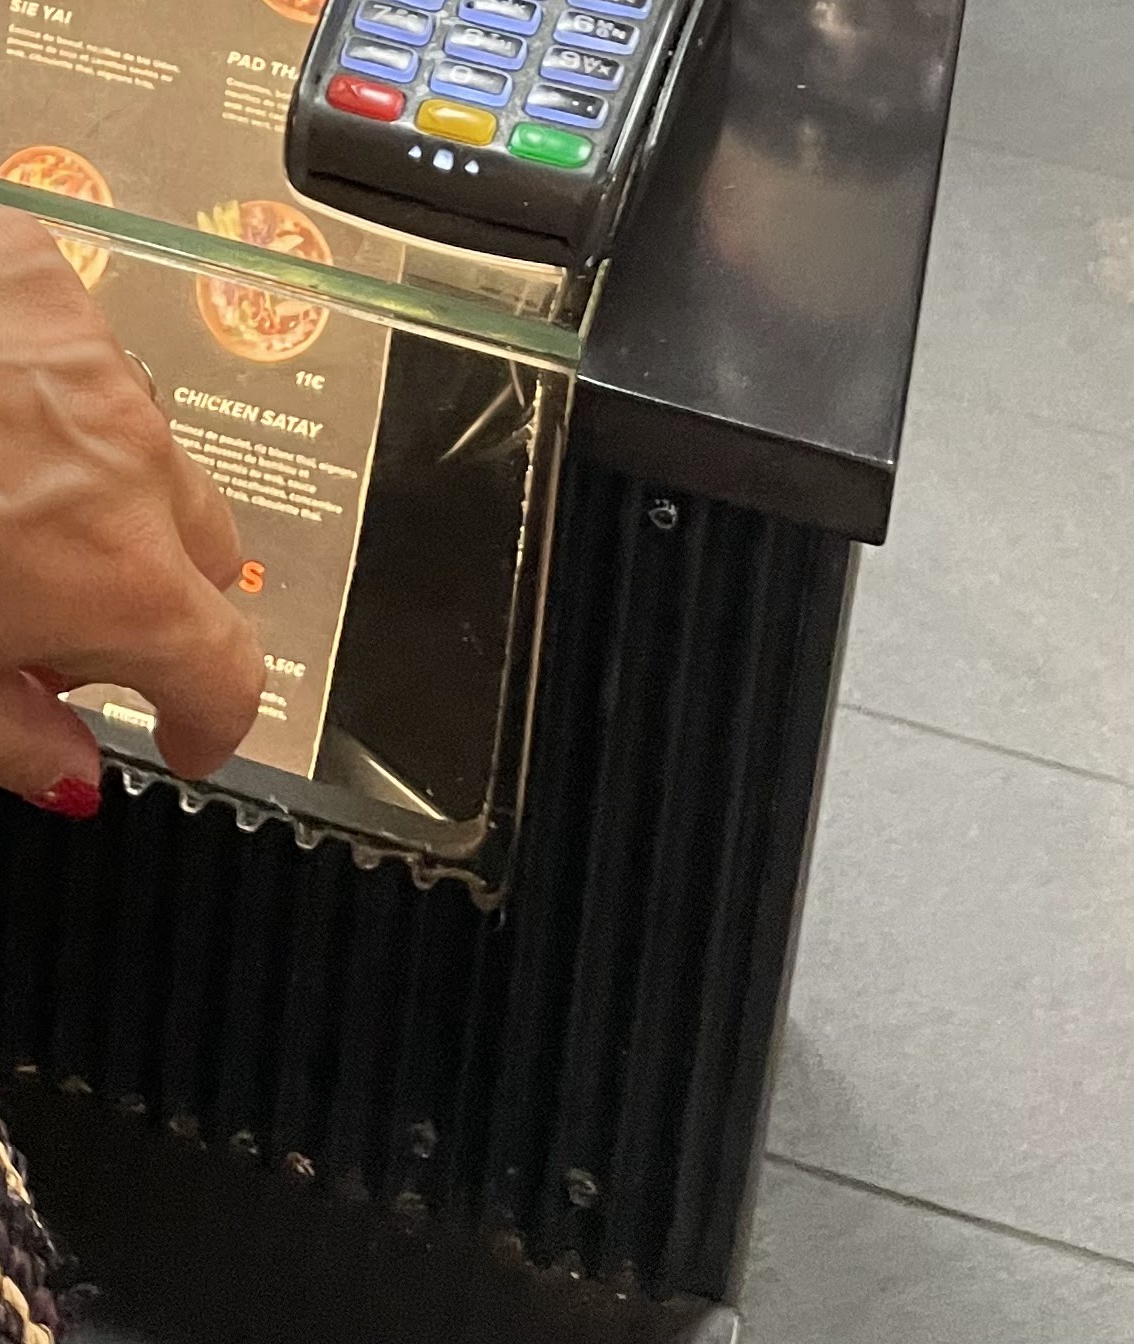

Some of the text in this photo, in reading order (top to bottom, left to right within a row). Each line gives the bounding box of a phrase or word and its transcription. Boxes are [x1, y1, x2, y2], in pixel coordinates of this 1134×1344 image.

[42, 5, 73, 24] YAI
[227, 51, 299, 80] PAD TH
[173, 387, 323, 438] CHICKEN SATAY
